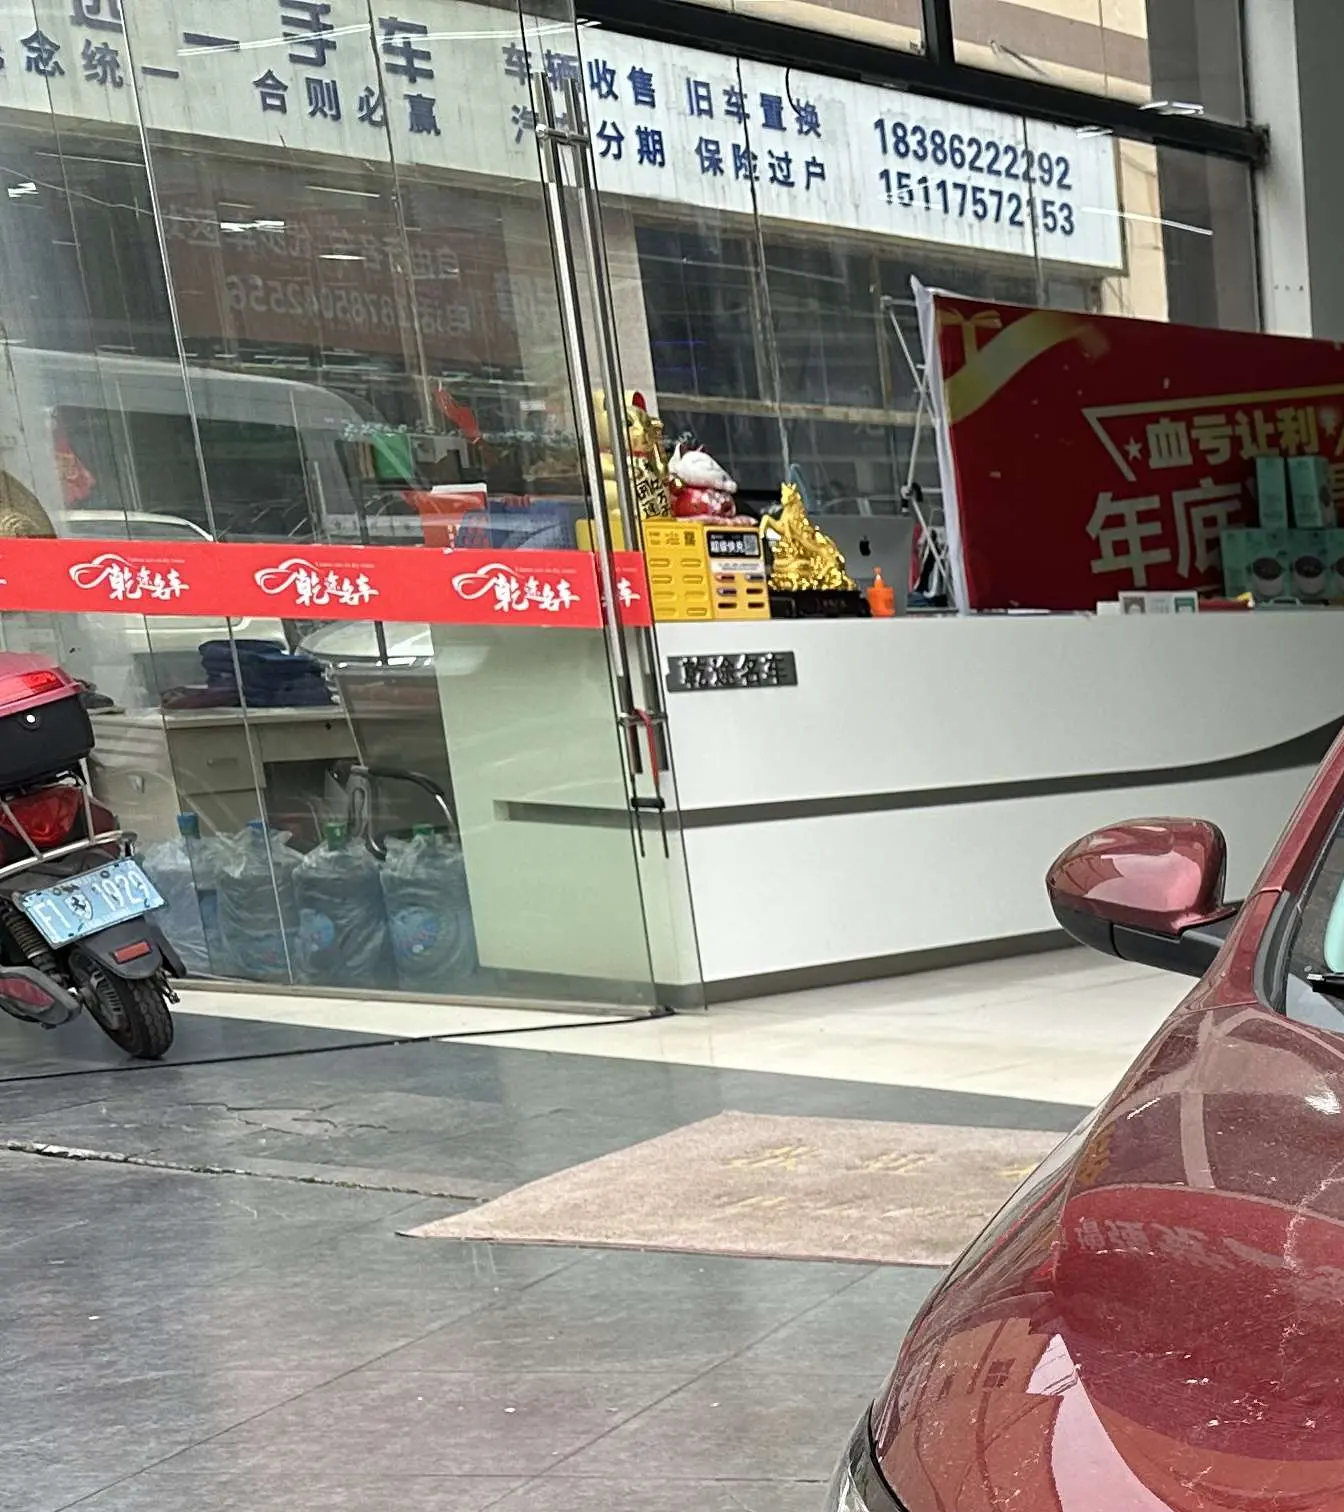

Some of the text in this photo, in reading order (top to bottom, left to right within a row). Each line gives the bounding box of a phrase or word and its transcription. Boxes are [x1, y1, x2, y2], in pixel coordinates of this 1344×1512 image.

[0, 29, 441, 137] 念统一 合则必赢
[685, 77, 822, 139] 旧车置换
[510, 102, 827, 191] 汽分期 保险过户
[873, 117, 1073, 191] 18386222292
[878, 168, 1075, 236] 15117572153
[1144, 406, 1319, 469] 血亏让利
